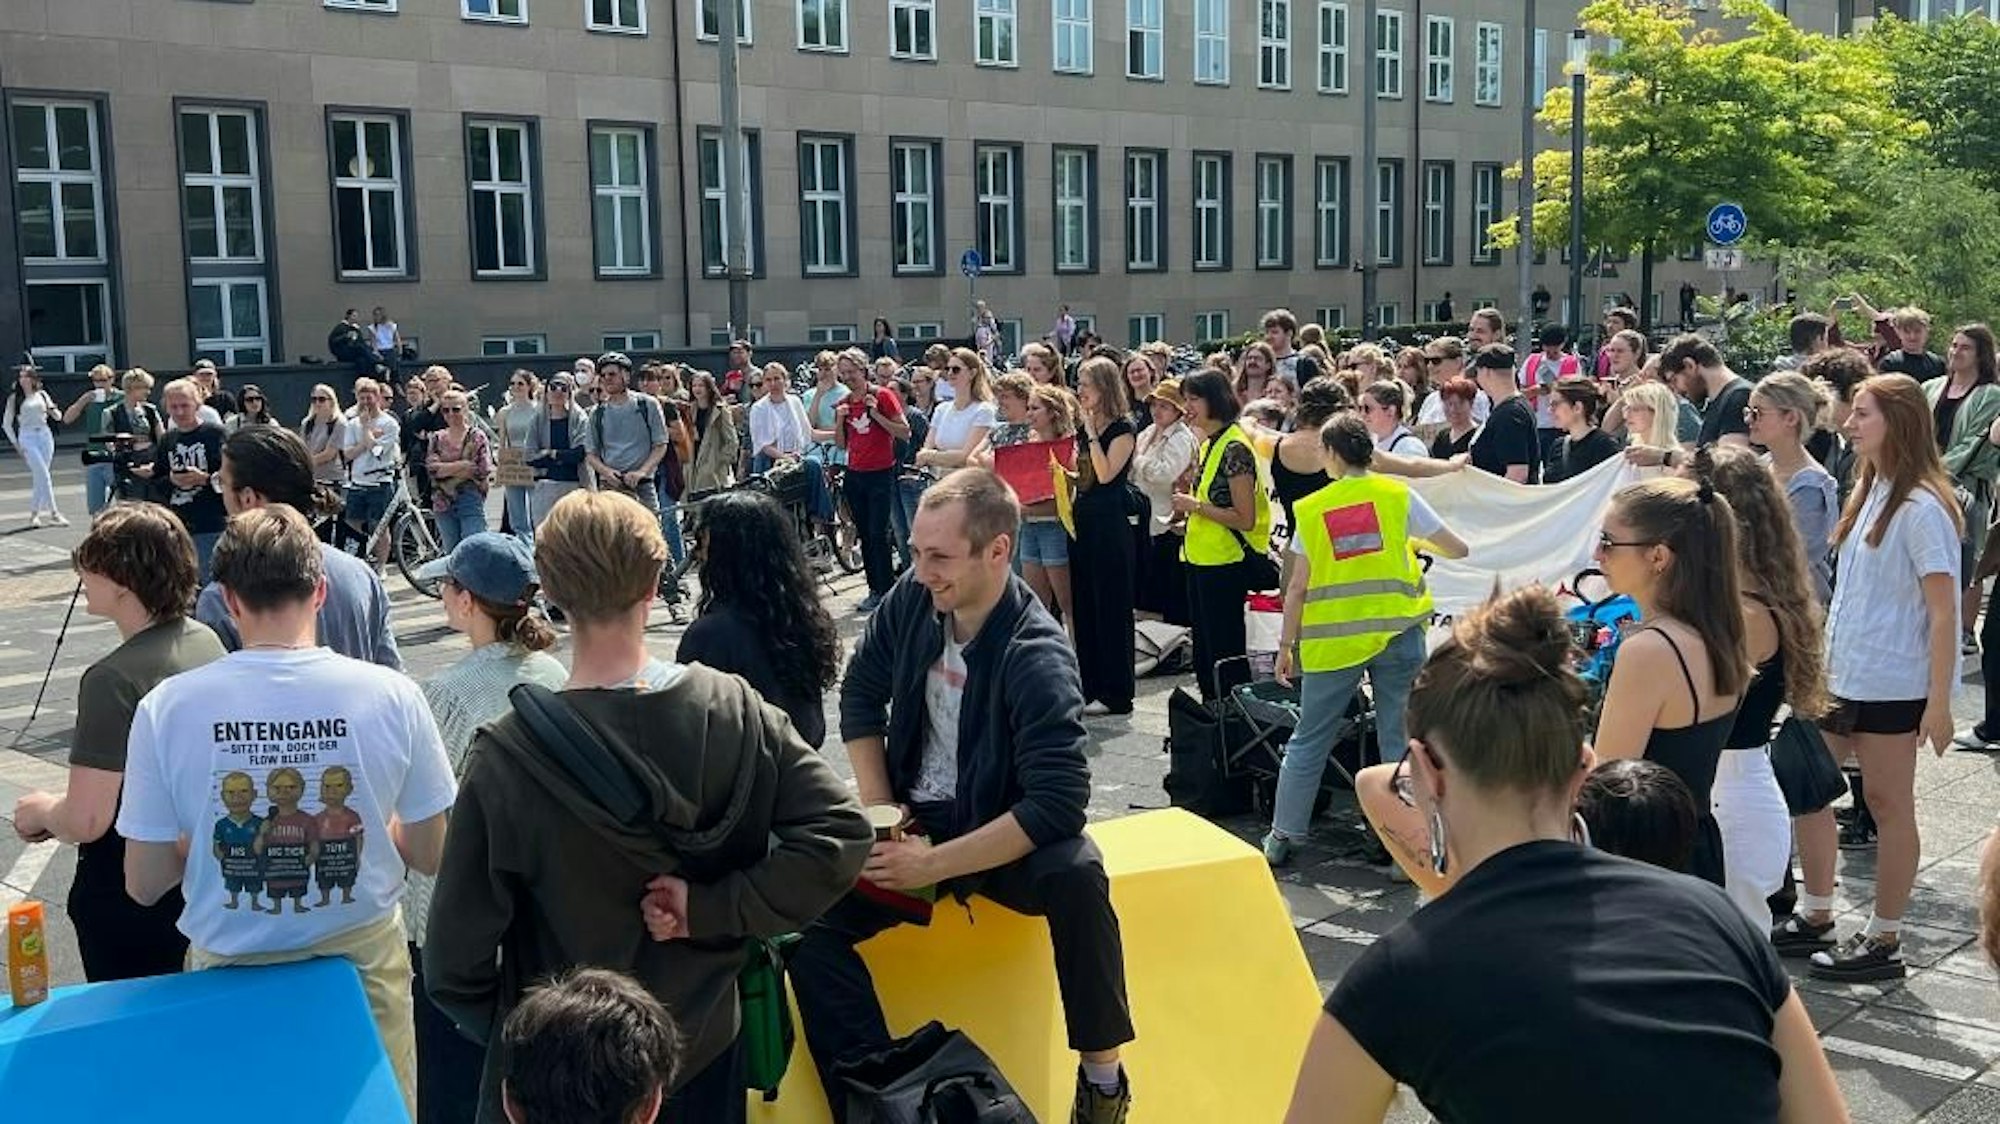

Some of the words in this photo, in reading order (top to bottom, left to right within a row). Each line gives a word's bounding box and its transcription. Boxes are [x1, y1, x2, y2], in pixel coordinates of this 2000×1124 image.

[213, 718, 347, 743] ENTENGANG
[287, 742, 316, 752] DOCH
[318, 740, 338, 751] DER
[249, 755, 278, 765] FLOW
